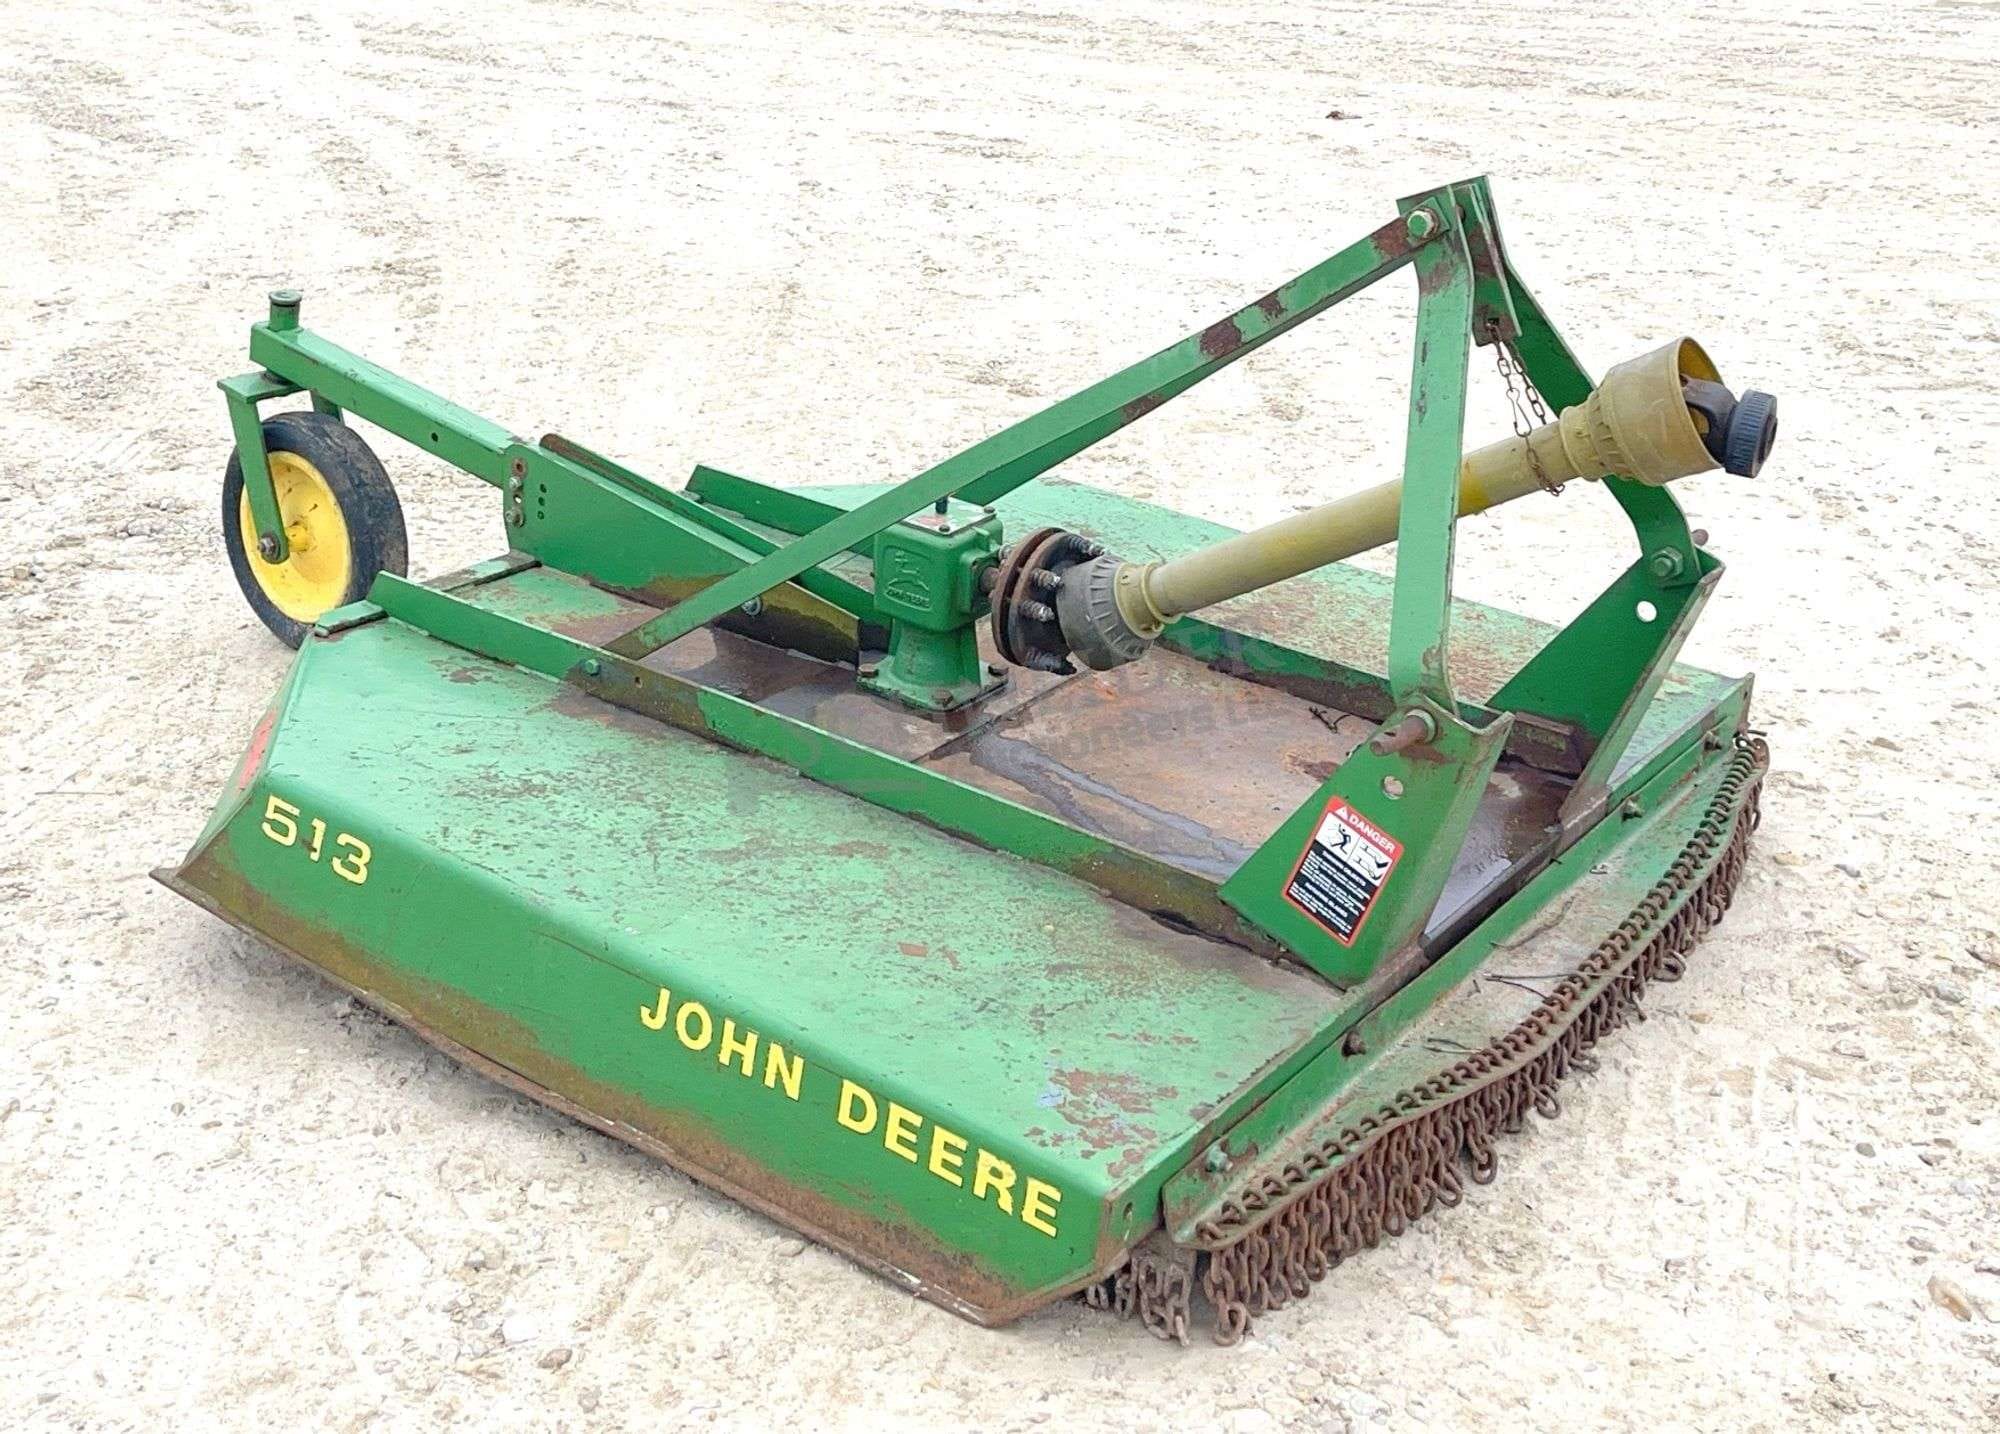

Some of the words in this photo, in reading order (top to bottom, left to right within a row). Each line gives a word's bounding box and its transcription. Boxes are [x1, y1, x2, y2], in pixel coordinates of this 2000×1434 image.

[262, 795, 371, 884] 513
[1349, 815, 1396, 855] DANGER
[640, 988, 805, 1101] JOHN
[837, 1079, 1062, 1237] DEERE
